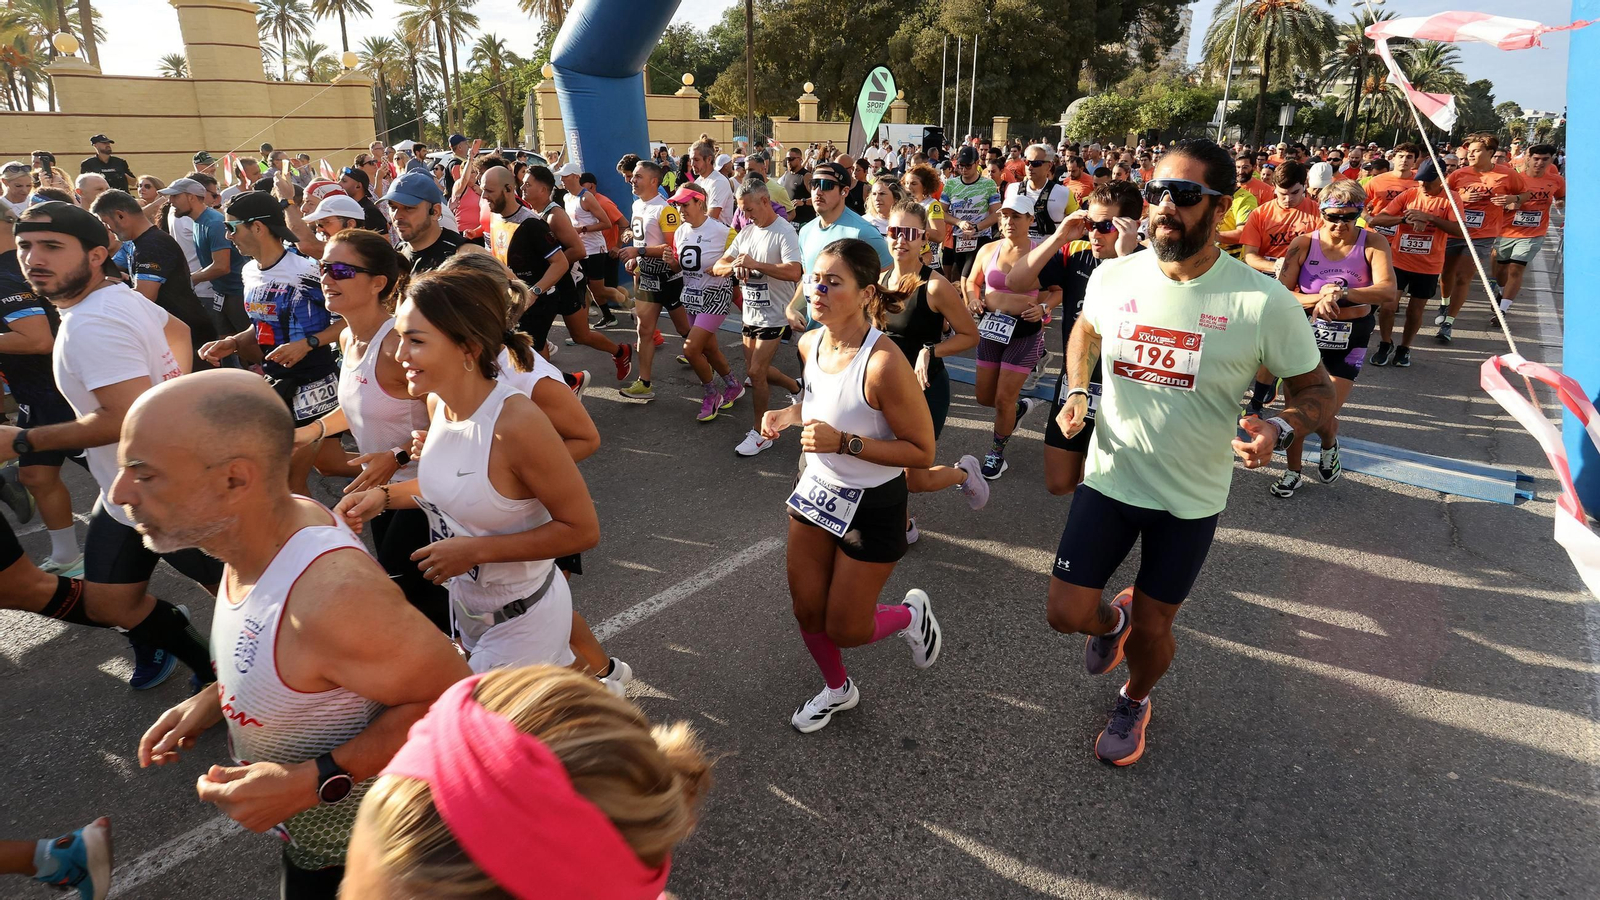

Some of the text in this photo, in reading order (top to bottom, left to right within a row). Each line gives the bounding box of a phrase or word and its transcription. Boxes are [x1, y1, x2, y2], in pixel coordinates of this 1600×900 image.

[1530, 191, 1550, 199] XIX
[1407, 240, 1424, 248] 333
[1346, 269, 1363, 282] vuela
[683, 294, 700, 304] 1004
[747, 290, 761, 300] 999
[1200, 318, 1218, 326] BERLIN
[1201, 313, 1219, 322] BMW
[985, 320, 1007, 334] 1014
[1199, 322, 1227, 332] MARATHON
[1138, 332, 1161, 344] XXIX
[1314, 329, 1337, 341] 621
[1135, 344, 1175, 369] 196
[301, 384, 335, 406] 1120
[808, 485, 838, 513] 686
